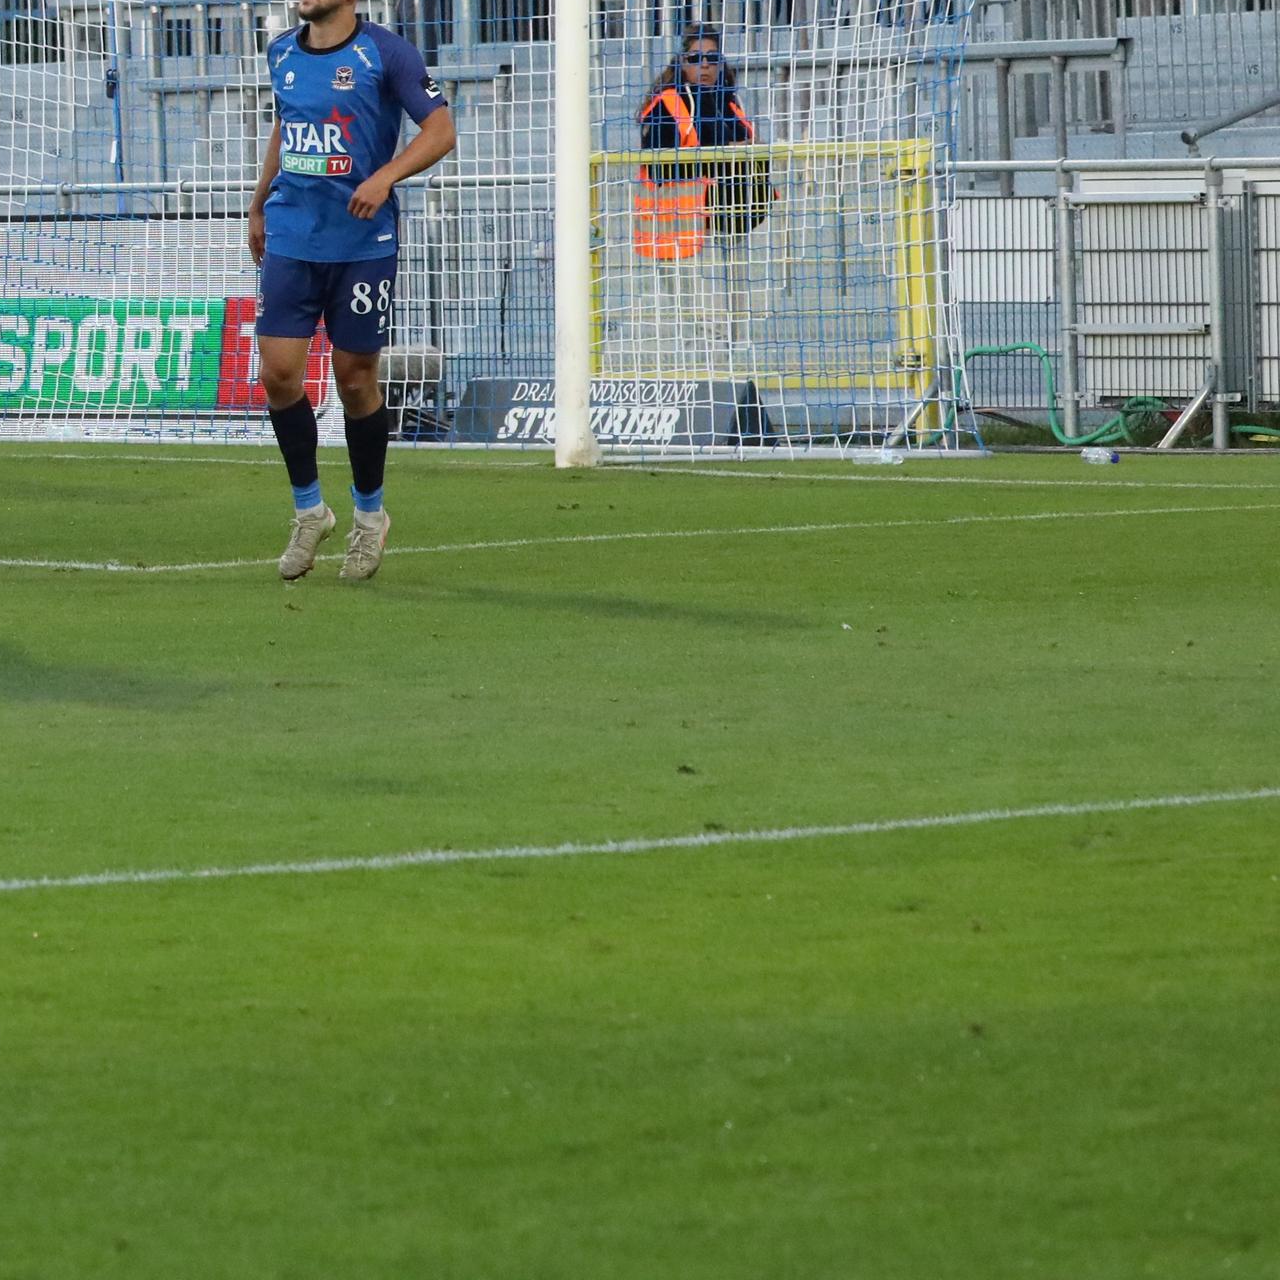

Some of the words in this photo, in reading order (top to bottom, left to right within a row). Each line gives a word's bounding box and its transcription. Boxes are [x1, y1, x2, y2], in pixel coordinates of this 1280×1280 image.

[281, 121, 347, 154] STAR
[284, 155, 326, 173] SPORT
[331, 157, 348, 170] TV
[350, 279, 391, 315] 88
[511, 382, 697, 402] DRANDISCOUNT
